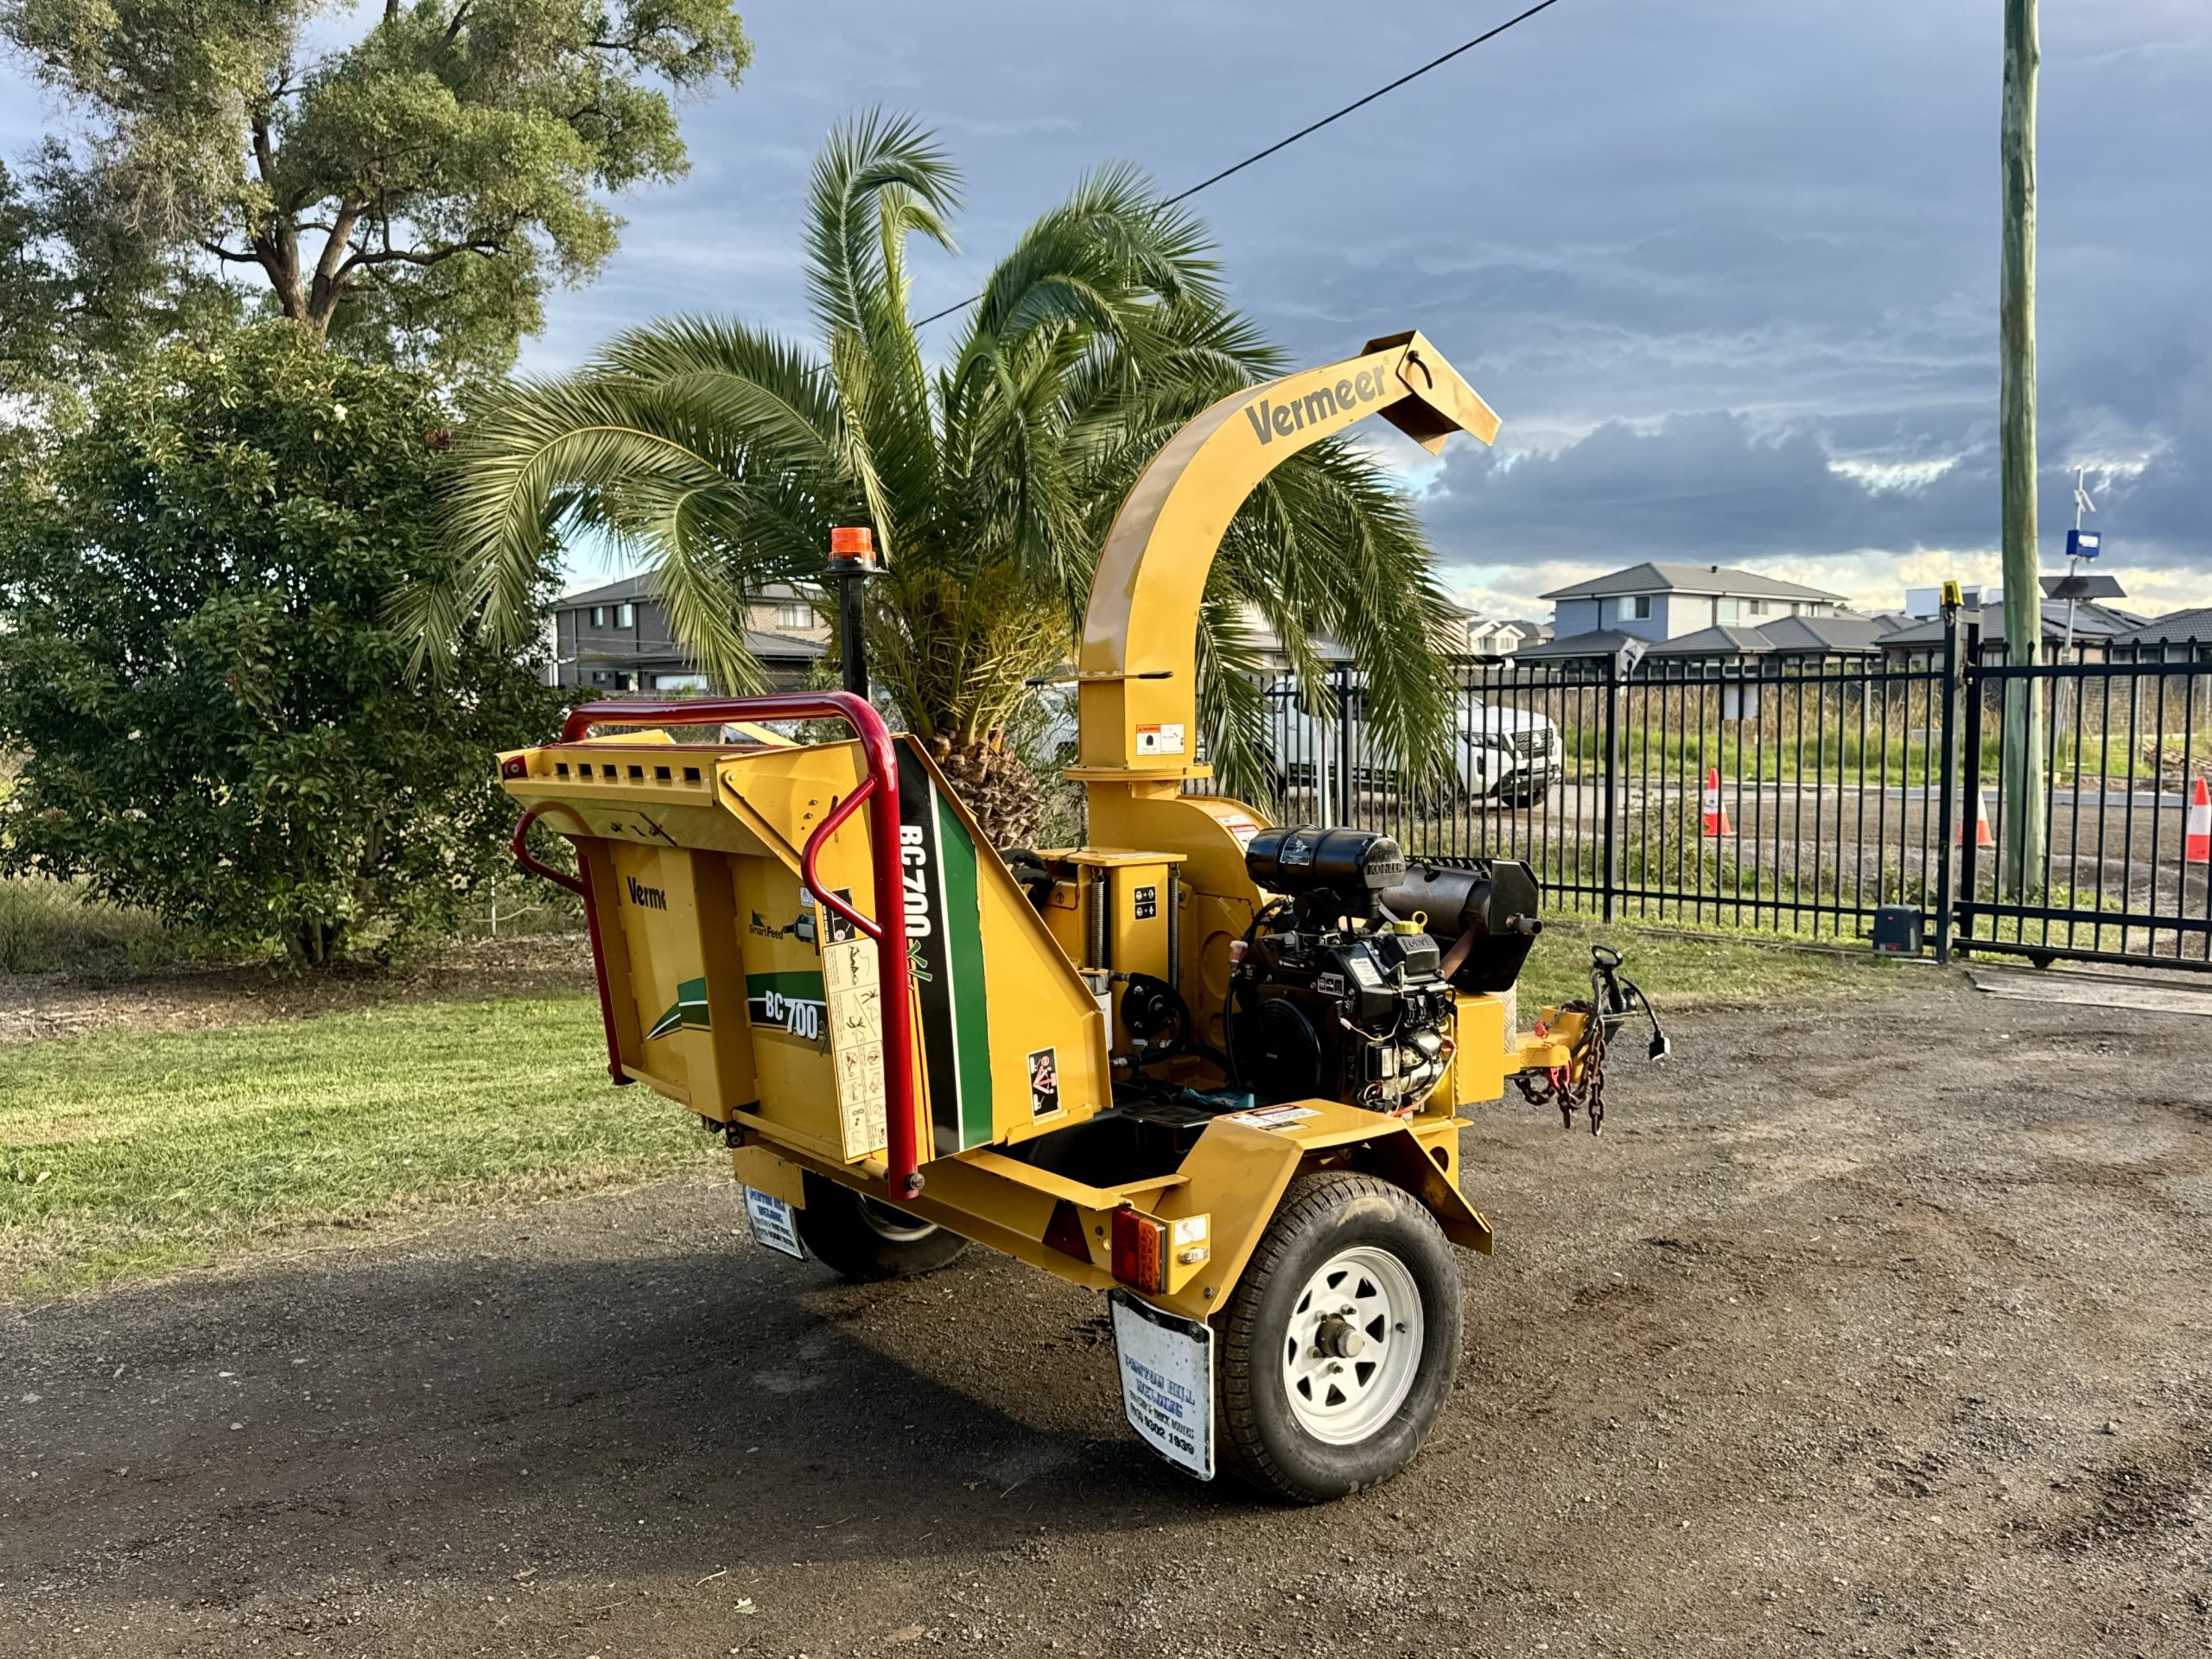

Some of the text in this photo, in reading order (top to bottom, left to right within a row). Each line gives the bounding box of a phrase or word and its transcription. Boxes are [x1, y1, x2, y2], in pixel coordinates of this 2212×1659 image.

[1244, 364, 1385, 446] Vermeer
[899, 825, 931, 938] BC700
[1367, 862, 1404, 874] KOHLER
[1168, 1432, 1195, 1456] 1939
